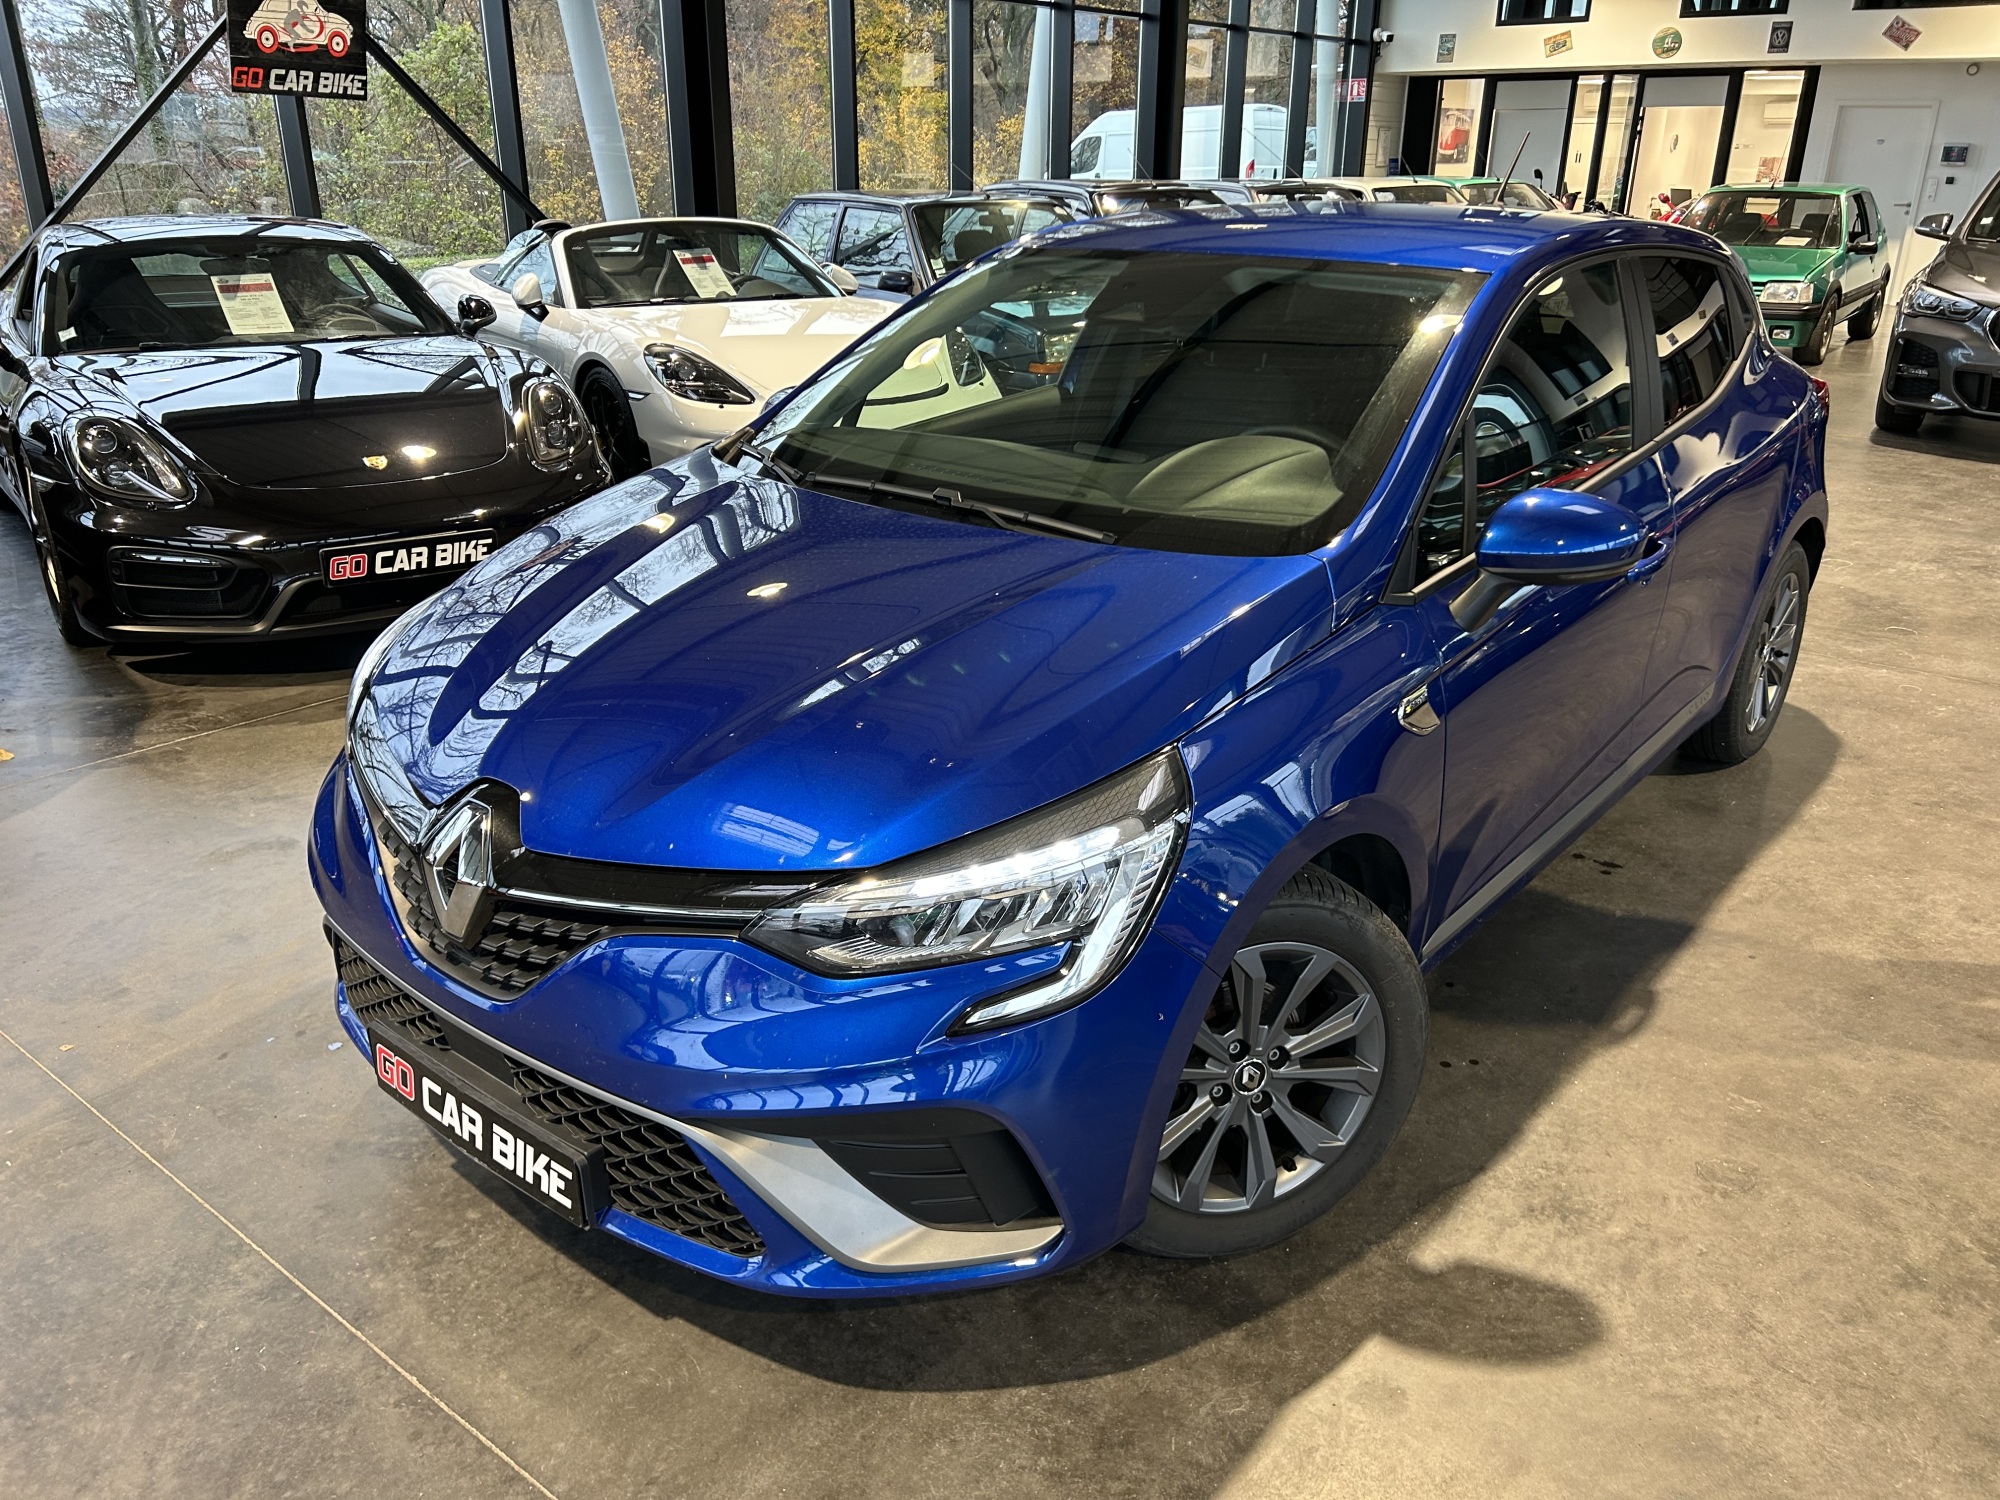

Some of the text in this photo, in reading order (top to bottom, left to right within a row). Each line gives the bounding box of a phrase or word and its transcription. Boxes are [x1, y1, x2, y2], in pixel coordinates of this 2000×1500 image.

[232, 66, 367, 96] GO CAR BIKE
[329, 538, 493, 581] GO CAR BIKE
[375, 1042, 573, 1210] GO CAR BIKE
